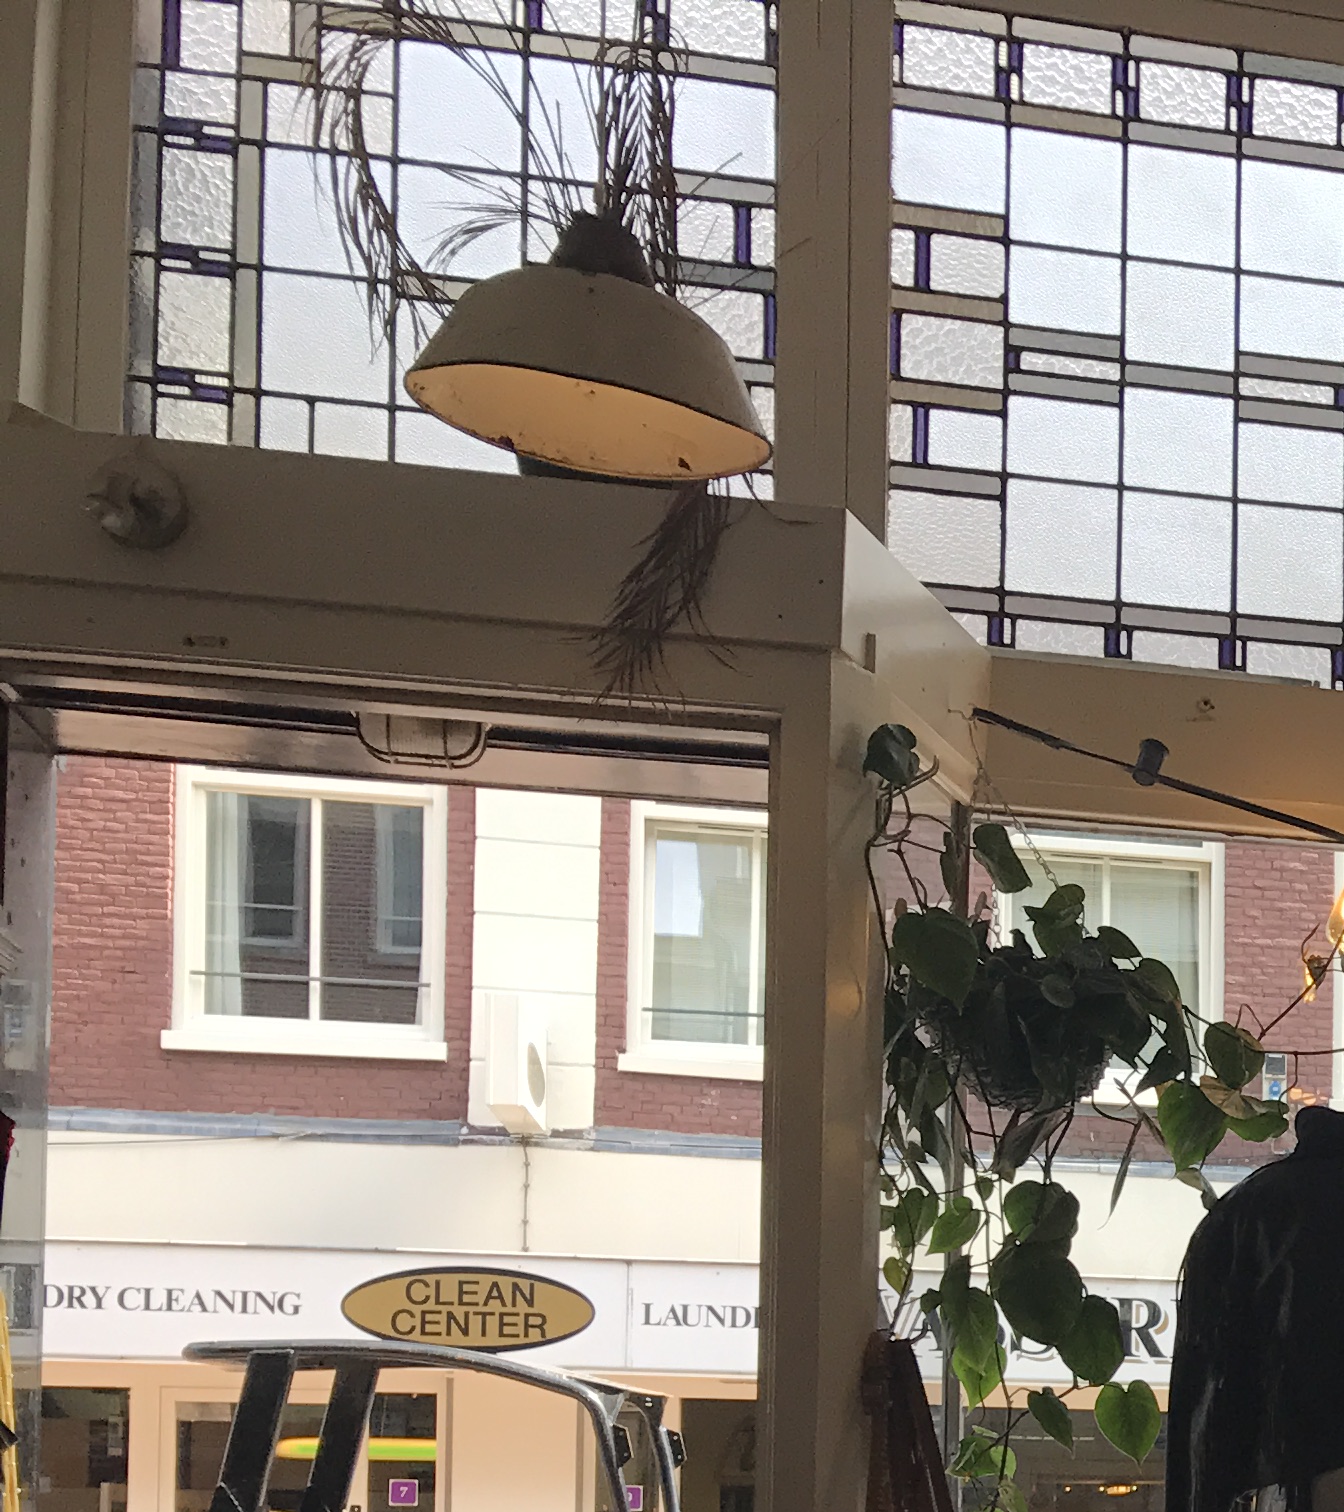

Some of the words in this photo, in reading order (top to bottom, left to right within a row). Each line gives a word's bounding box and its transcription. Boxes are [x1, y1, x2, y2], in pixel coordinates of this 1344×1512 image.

[44, 1284, 111, 1310] DRY
[117, 1286, 302, 1316] CLEANING
[405, 1279, 535, 1308] CLEAN
[391, 1309, 547, 1338] CENTER
[399, 1487, 408, 1497] 7
